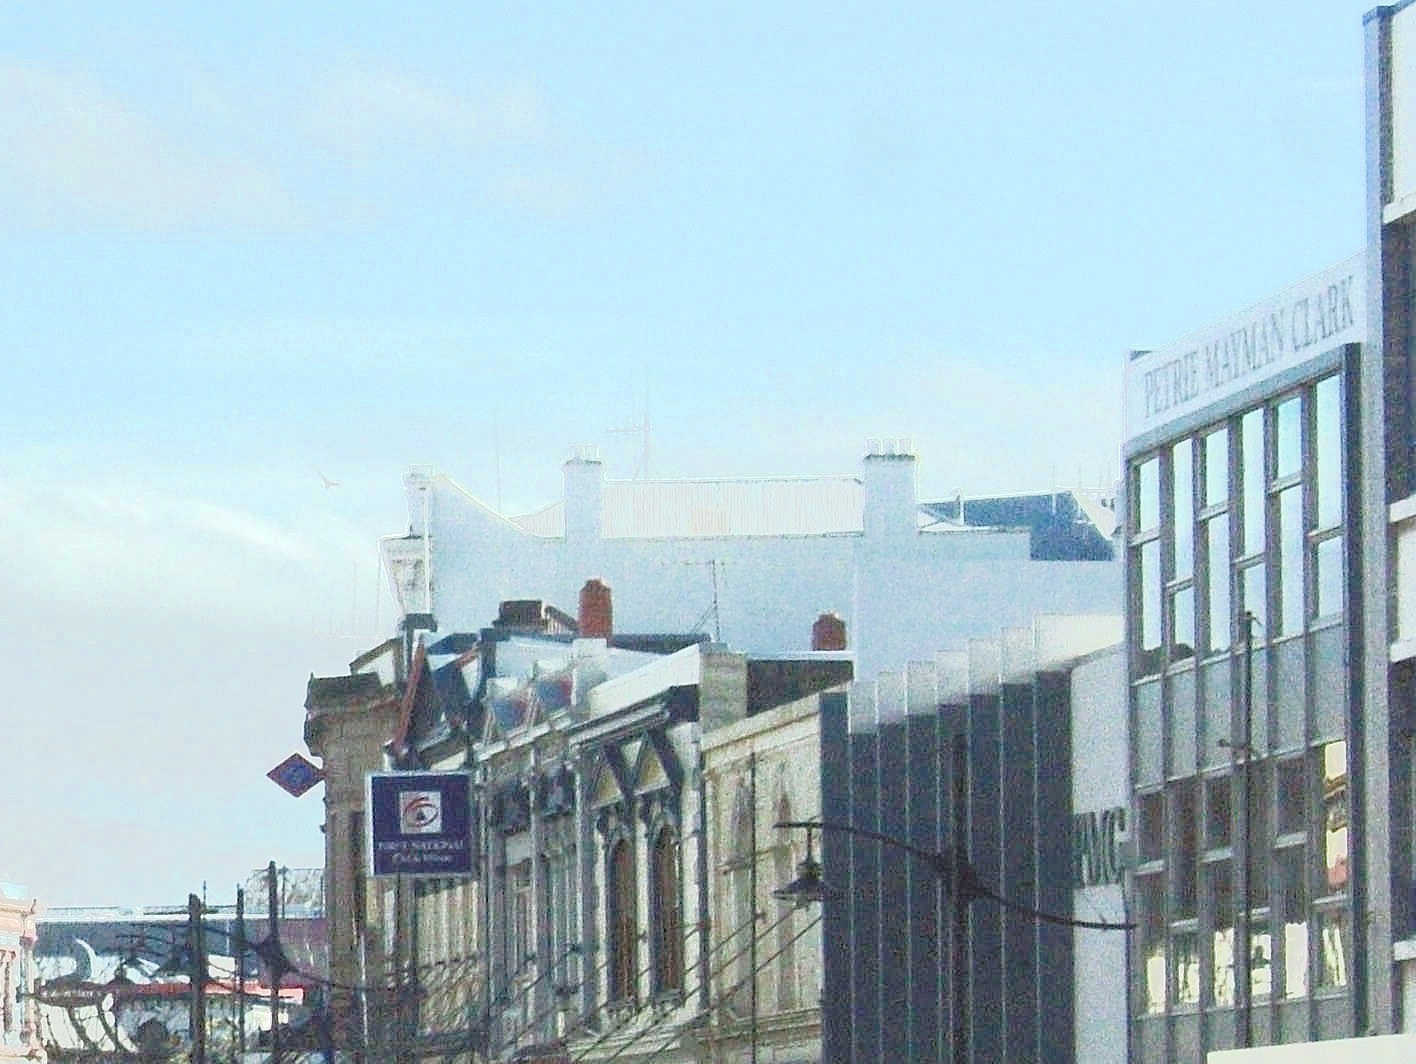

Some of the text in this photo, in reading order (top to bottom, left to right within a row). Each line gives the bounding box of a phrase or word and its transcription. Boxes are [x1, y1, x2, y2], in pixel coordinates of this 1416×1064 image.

[1143, 273, 1355, 418] PETRIE MAYMAN CLARK
